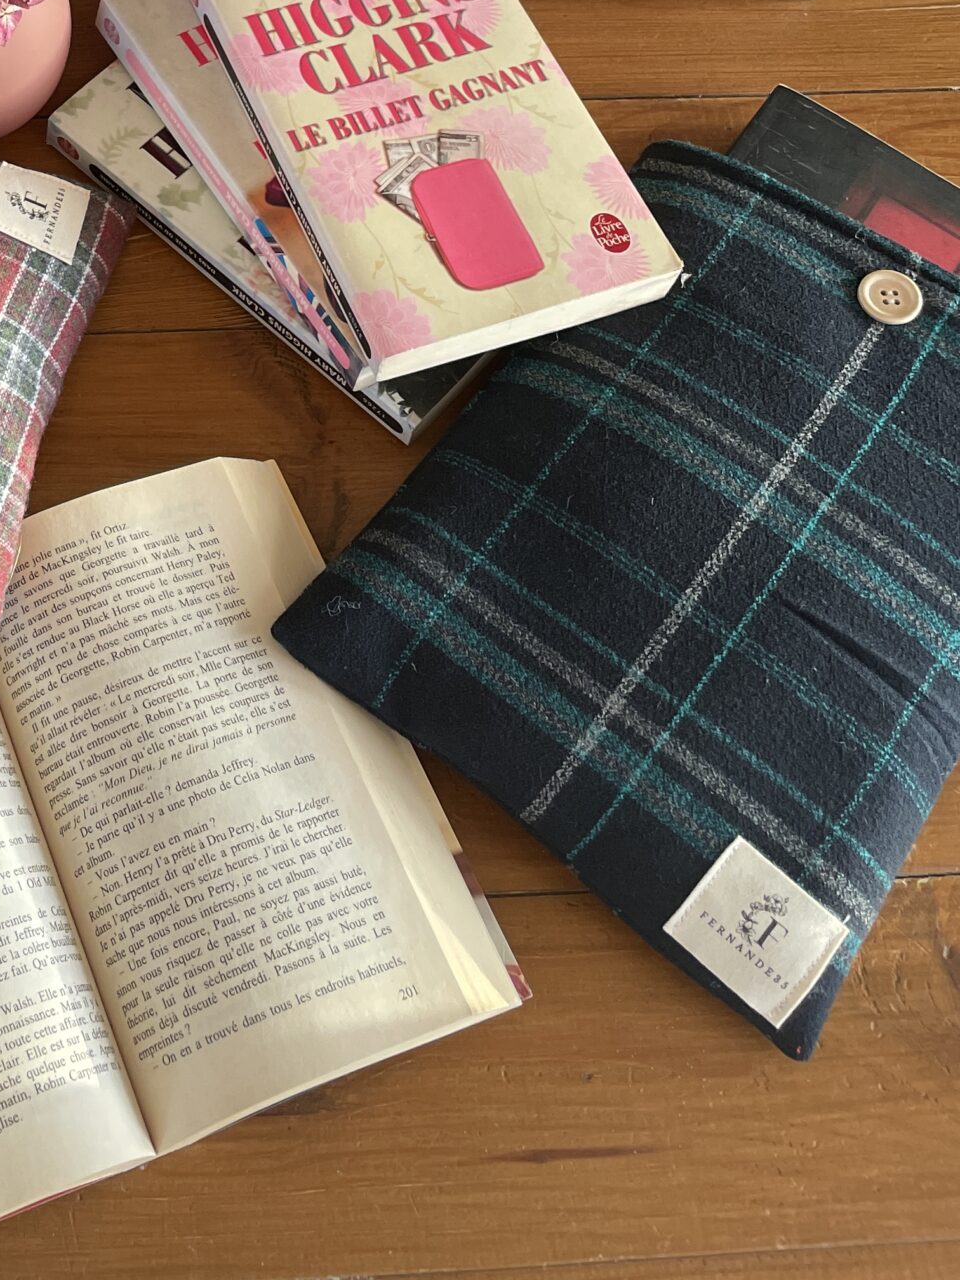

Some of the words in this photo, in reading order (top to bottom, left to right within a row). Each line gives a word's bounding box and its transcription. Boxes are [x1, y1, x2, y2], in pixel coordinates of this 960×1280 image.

[298, 8, 492, 96] CLARK
[286, 123, 324, 152] LE
[326, 96, 424, 142] BILLET
[429, 59, 548, 111] GAGNANT
[592, 222, 623, 235] Livre
[597, 233, 630, 249] Poche
[162, 1052, 177, 1066] On
[180, 1045, 192, 1058] en
[196, 1040, 202, 1050] a
[205, 1022, 239, 1046] trouvé
[242, 1010, 267, 1028] dans
[270, 1000, 293, 1017] tous
[296, 993, 311, 1006] les
[315, 974, 355, 998] endroits
[358, 955, 407, 980] habituels,
[399, 984, 419, 1001] 201
